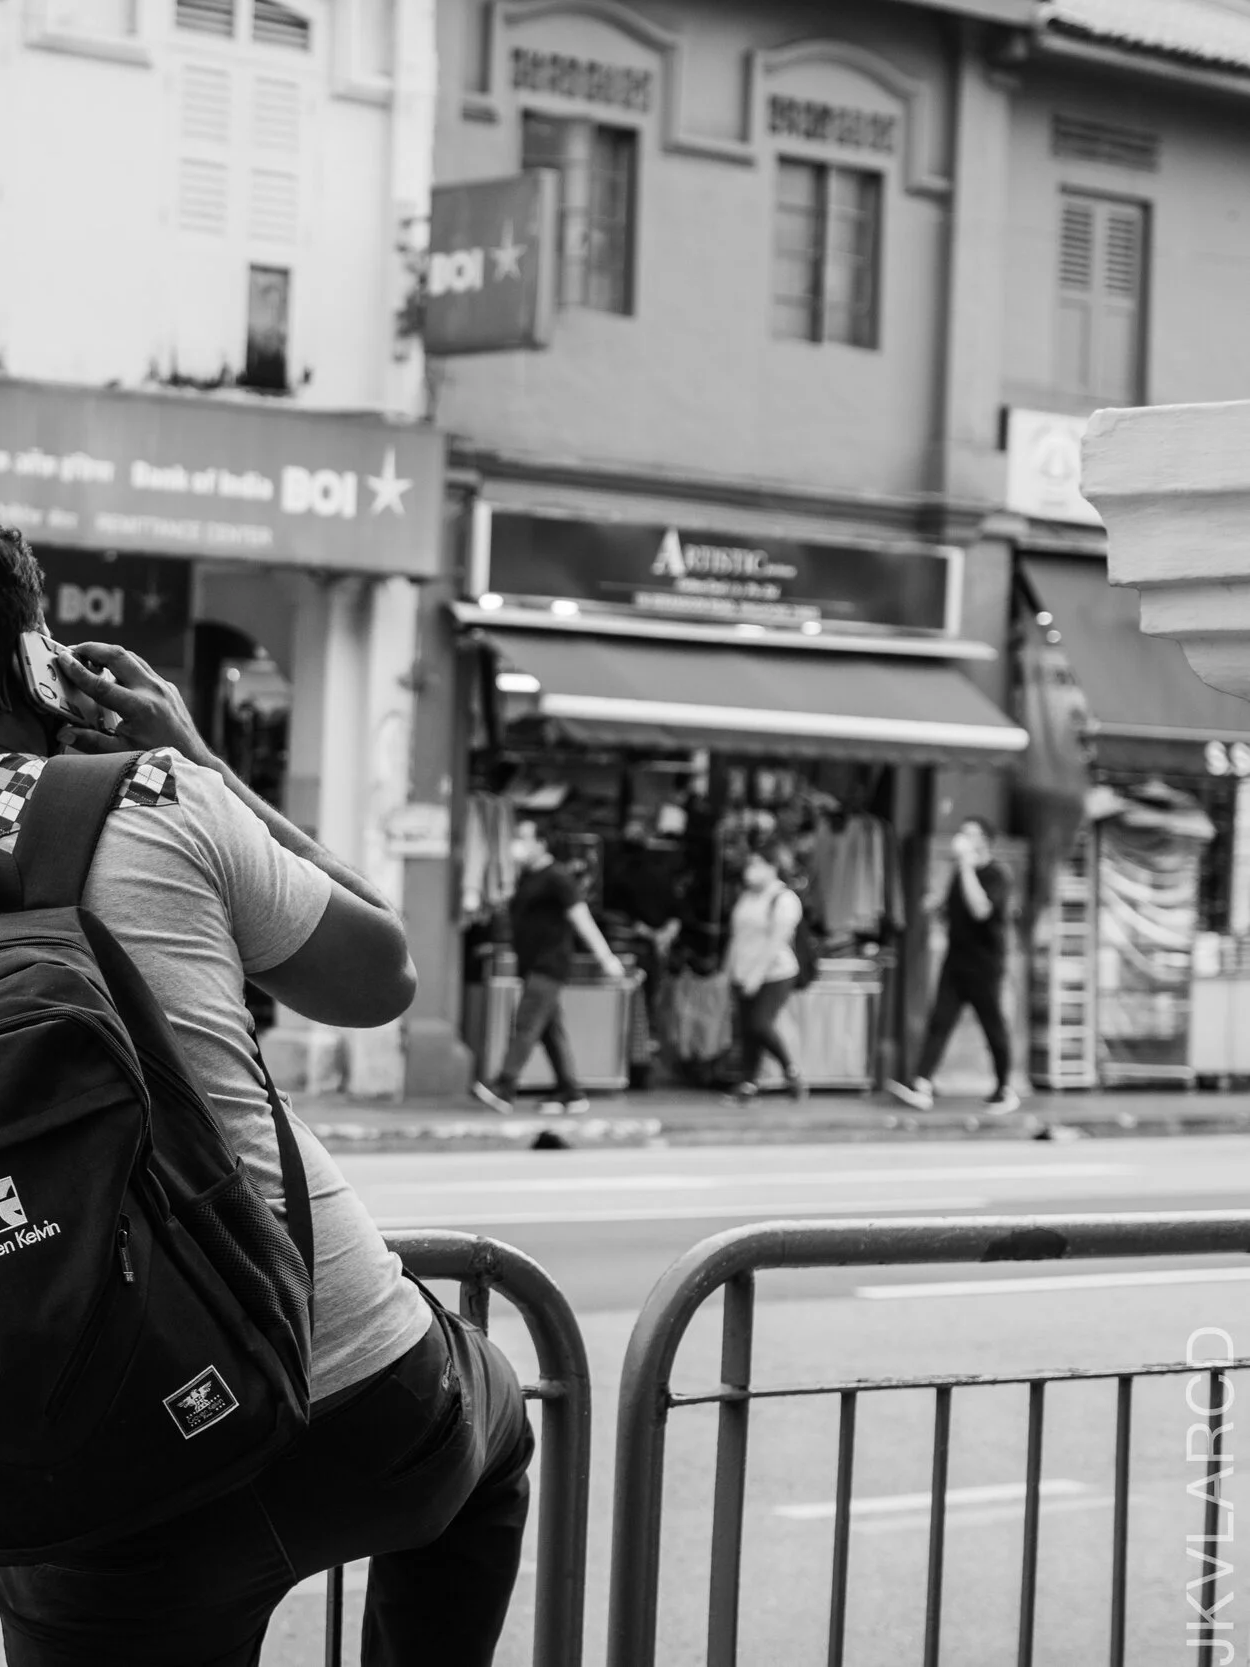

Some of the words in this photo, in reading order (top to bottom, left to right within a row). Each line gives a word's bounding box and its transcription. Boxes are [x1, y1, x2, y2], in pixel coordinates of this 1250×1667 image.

[281, 464, 357, 518] BOI
[58, 583, 125, 627] BOI
[14, 1220, 61, 1249] Kelvin
